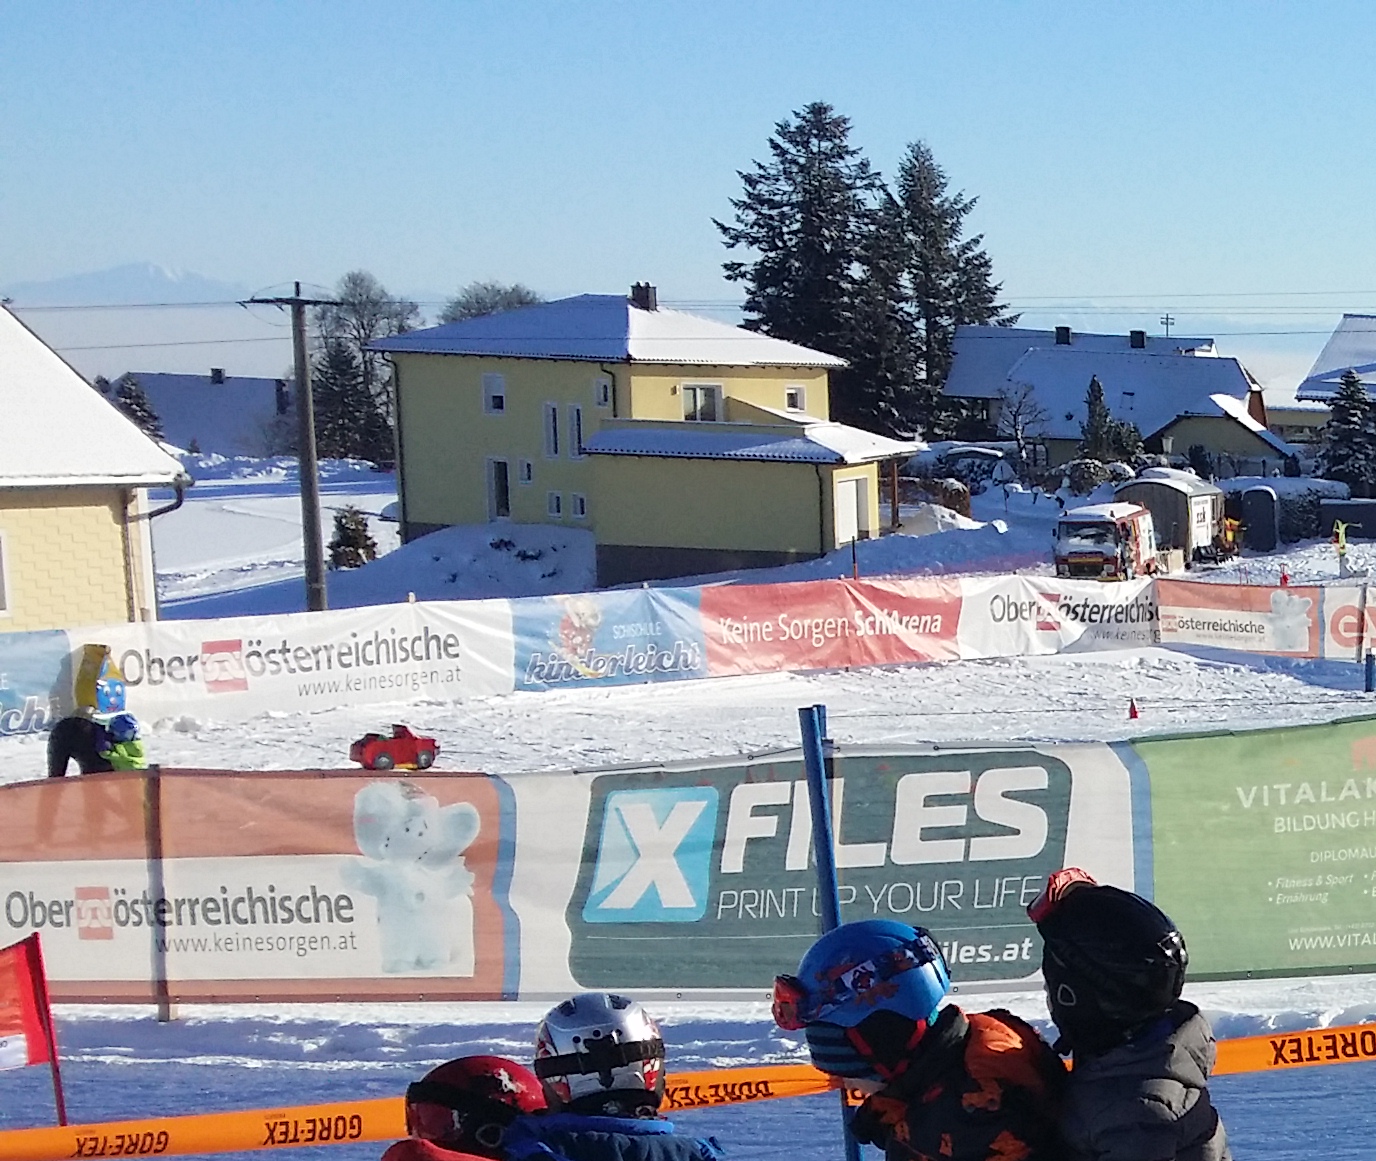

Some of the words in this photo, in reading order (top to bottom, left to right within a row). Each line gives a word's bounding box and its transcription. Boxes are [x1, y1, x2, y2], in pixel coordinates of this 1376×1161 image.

[990, 593, 1037, 623] Ober
[718, 615, 774, 645] Keine
[778, 612, 850, 648] Sorgen
[854, 607, 943, 638] SchiArena
[1178, 615, 1265, 634] österreichische
[119, 649, 198, 690] Ober
[242, 626, 461, 678] österreichische
[523, 640, 701, 685] kinderleicht
[297, 666, 462, 697] www.keinesorgen.at
[598, 800, 708, 910] X
[720, 766, 1049, 875] FILES
[1274, 811, 1361, 834] BILDUNG
[1275, 876, 1313, 889] Fitness
[1325, 873, 1354, 887] Sport
[4, 889, 74, 929] Ober
[112, 885, 355, 928] österreichische
[717, 888, 804, 920] PRINT
[863, 879, 964, 915] YOUR
[973, 875, 1042, 909] LIFE
[155, 930, 358, 958] www.keinesorgen.at
[938, 937, 1033, 964] iles.at
[70, 1130, 170, 1158] GORE-TEX
[261, 1114, 363, 1146] GORE-TEX
